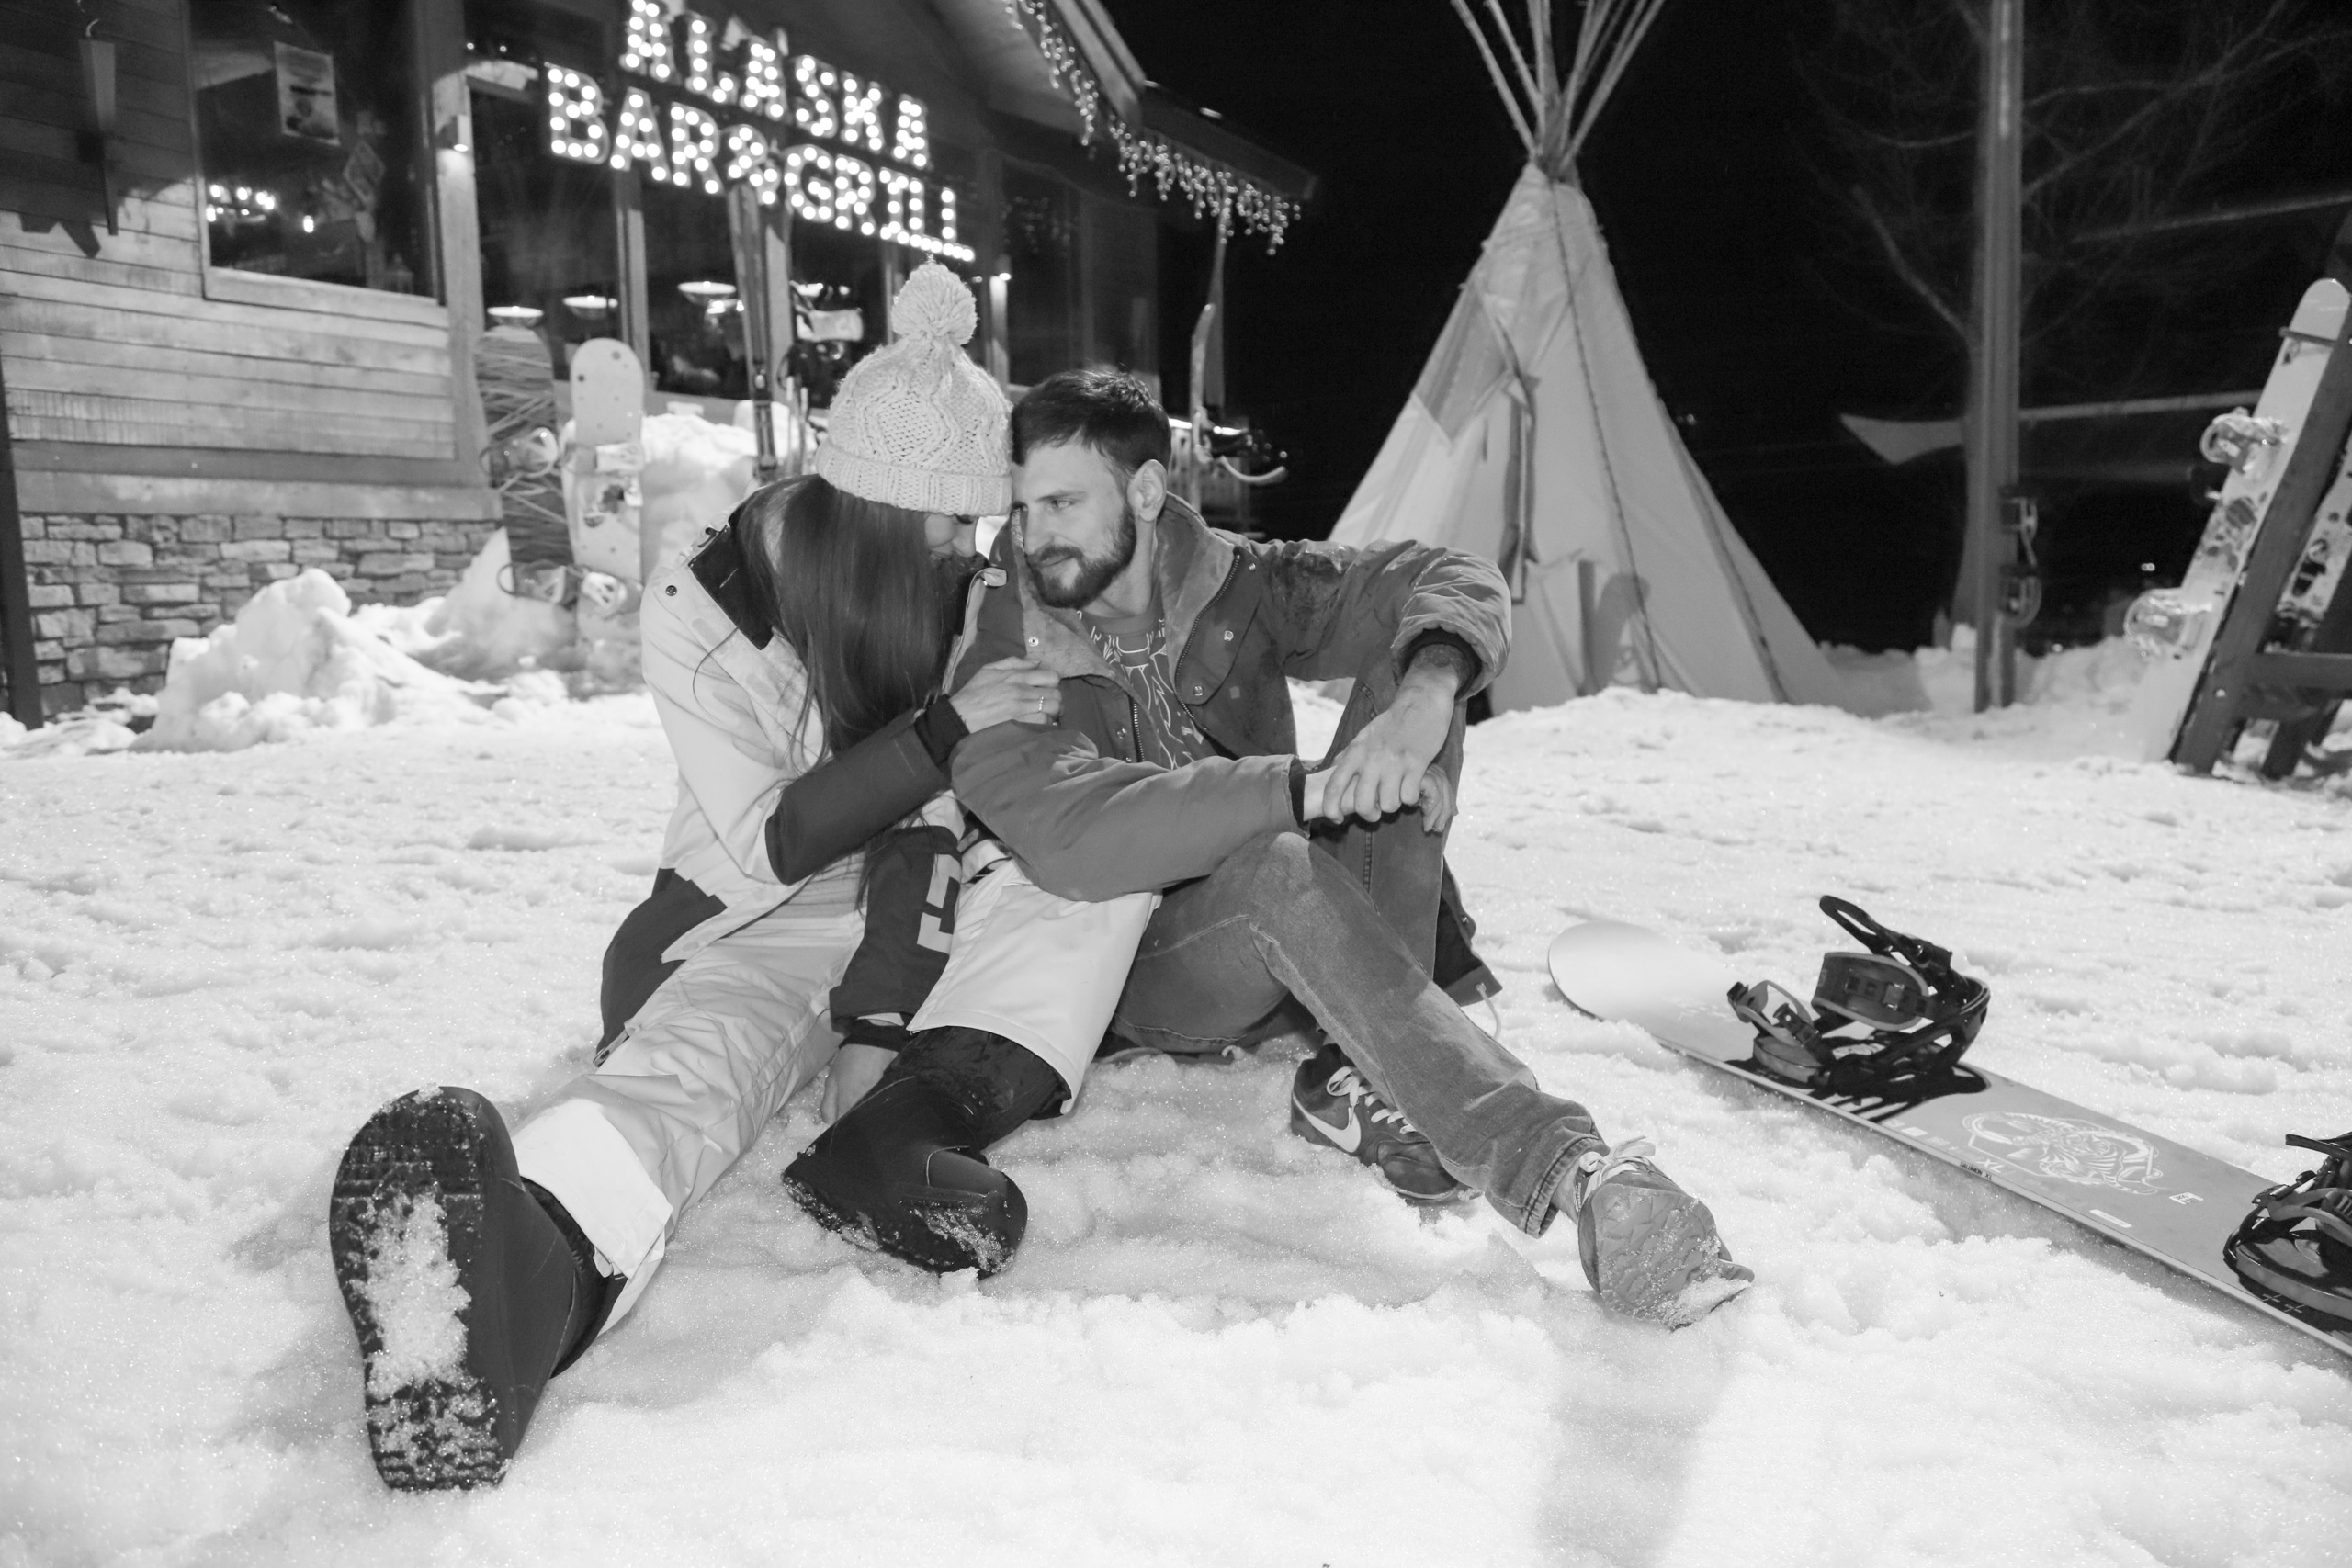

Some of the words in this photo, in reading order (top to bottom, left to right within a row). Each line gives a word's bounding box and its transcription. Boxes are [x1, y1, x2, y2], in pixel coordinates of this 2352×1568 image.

[548, 64, 724, 194] BAR
[729, 123, 779, 206] &
[783, 144, 975, 263] GRILL
[618, 0, 932, 171] ALASKA
